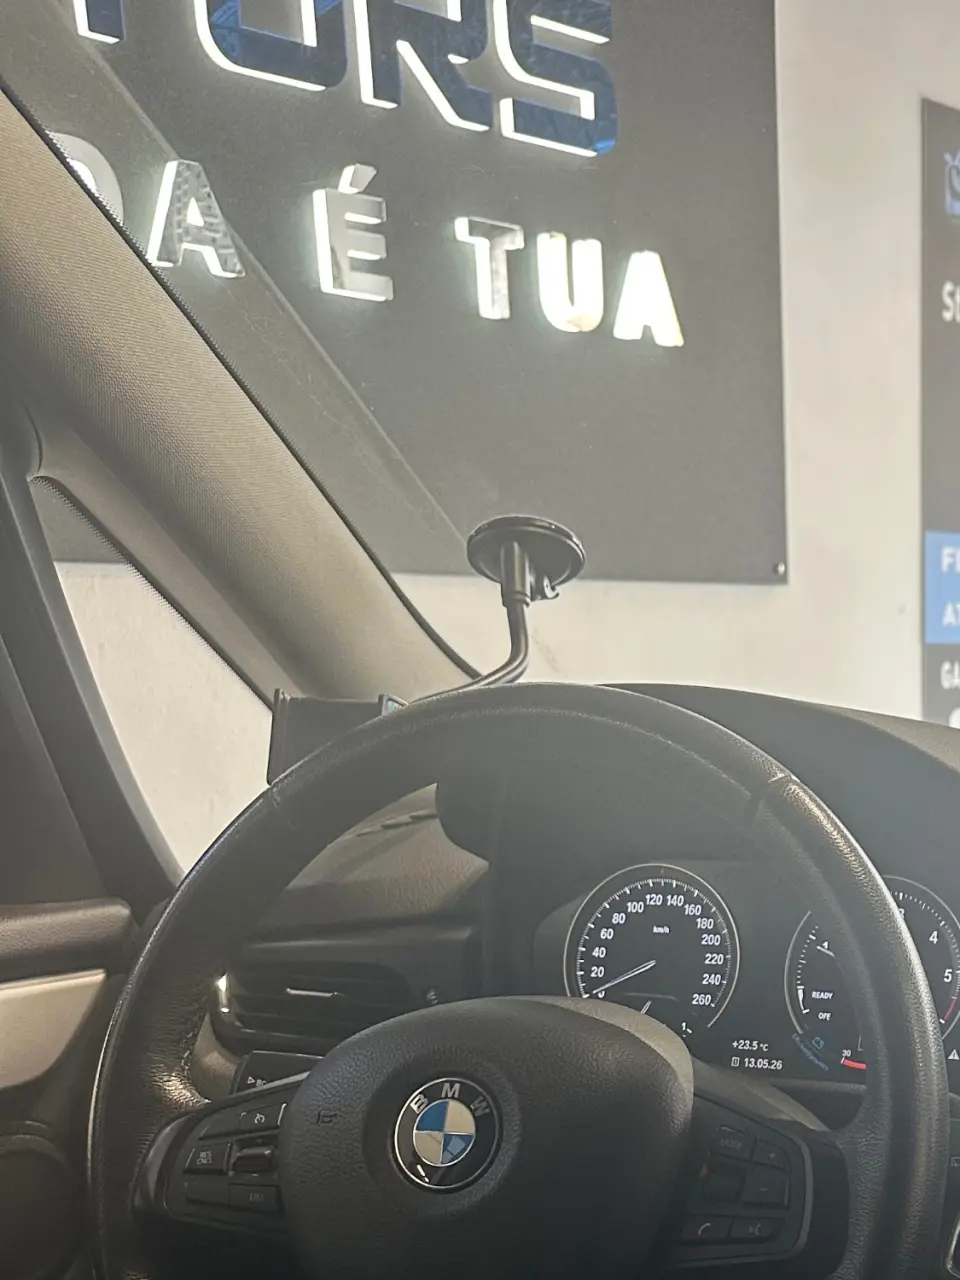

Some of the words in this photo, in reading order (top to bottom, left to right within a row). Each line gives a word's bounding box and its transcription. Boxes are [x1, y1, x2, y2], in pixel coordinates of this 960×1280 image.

[312, 163, 394, 302] É
[454, 215, 684, 347] TUA
[645, 893, 663, 906] 120
[666, 893, 684, 907] 140
[627, 902, 644, 913] 100
[684, 904, 702, 916] 160
[612, 912, 626, 925] 80
[696, 917, 714, 930] 180
[600, 928, 614, 940] 60
[653, 926, 669, 934] km/h
[701, 934, 721, 946] 200
[929, 931, 939, 944] 4
[592, 946, 606, 958] 40
[704, 953, 724, 965] 220
[591, 966, 605, 978] 20
[944, 968, 953, 983] 5
[702, 973, 722, 986] 240
[692, 994, 712, 1006] 260
[812, 991, 833, 999] READY
[818, 1012, 831, 1021] OFF
[681, 1022, 686, 1031] 1
[842, 1049, 851, 1057] 30
[744, 1057, 783, 1070] 13.05.26
[410, 1082, 490, 1117] BMW
